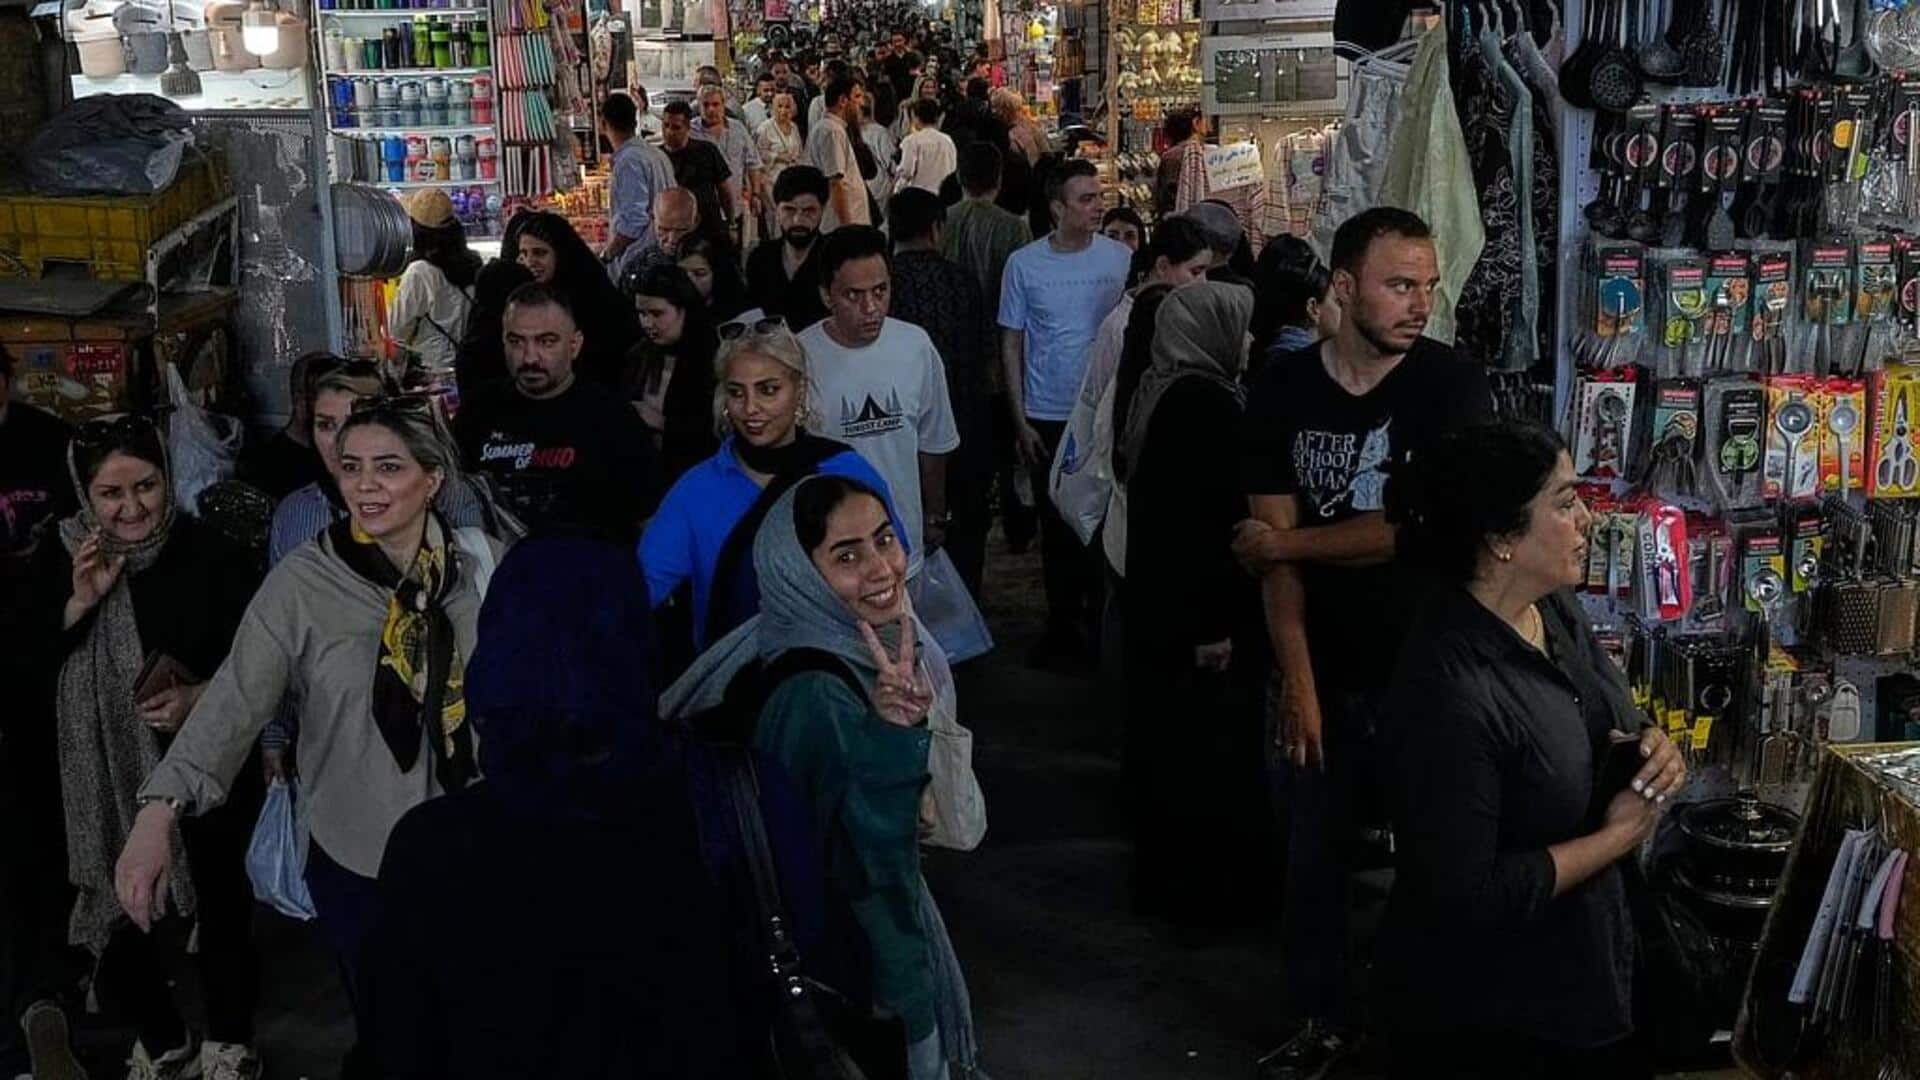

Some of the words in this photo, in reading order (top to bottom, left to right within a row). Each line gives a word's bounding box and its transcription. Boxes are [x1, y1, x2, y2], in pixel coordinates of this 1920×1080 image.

[480, 443, 535, 461] SUMMER
[1294, 429, 1358, 456] AFTER
[514, 456, 531, 470] OF
[1292, 448, 1357, 472] SCHOOL
